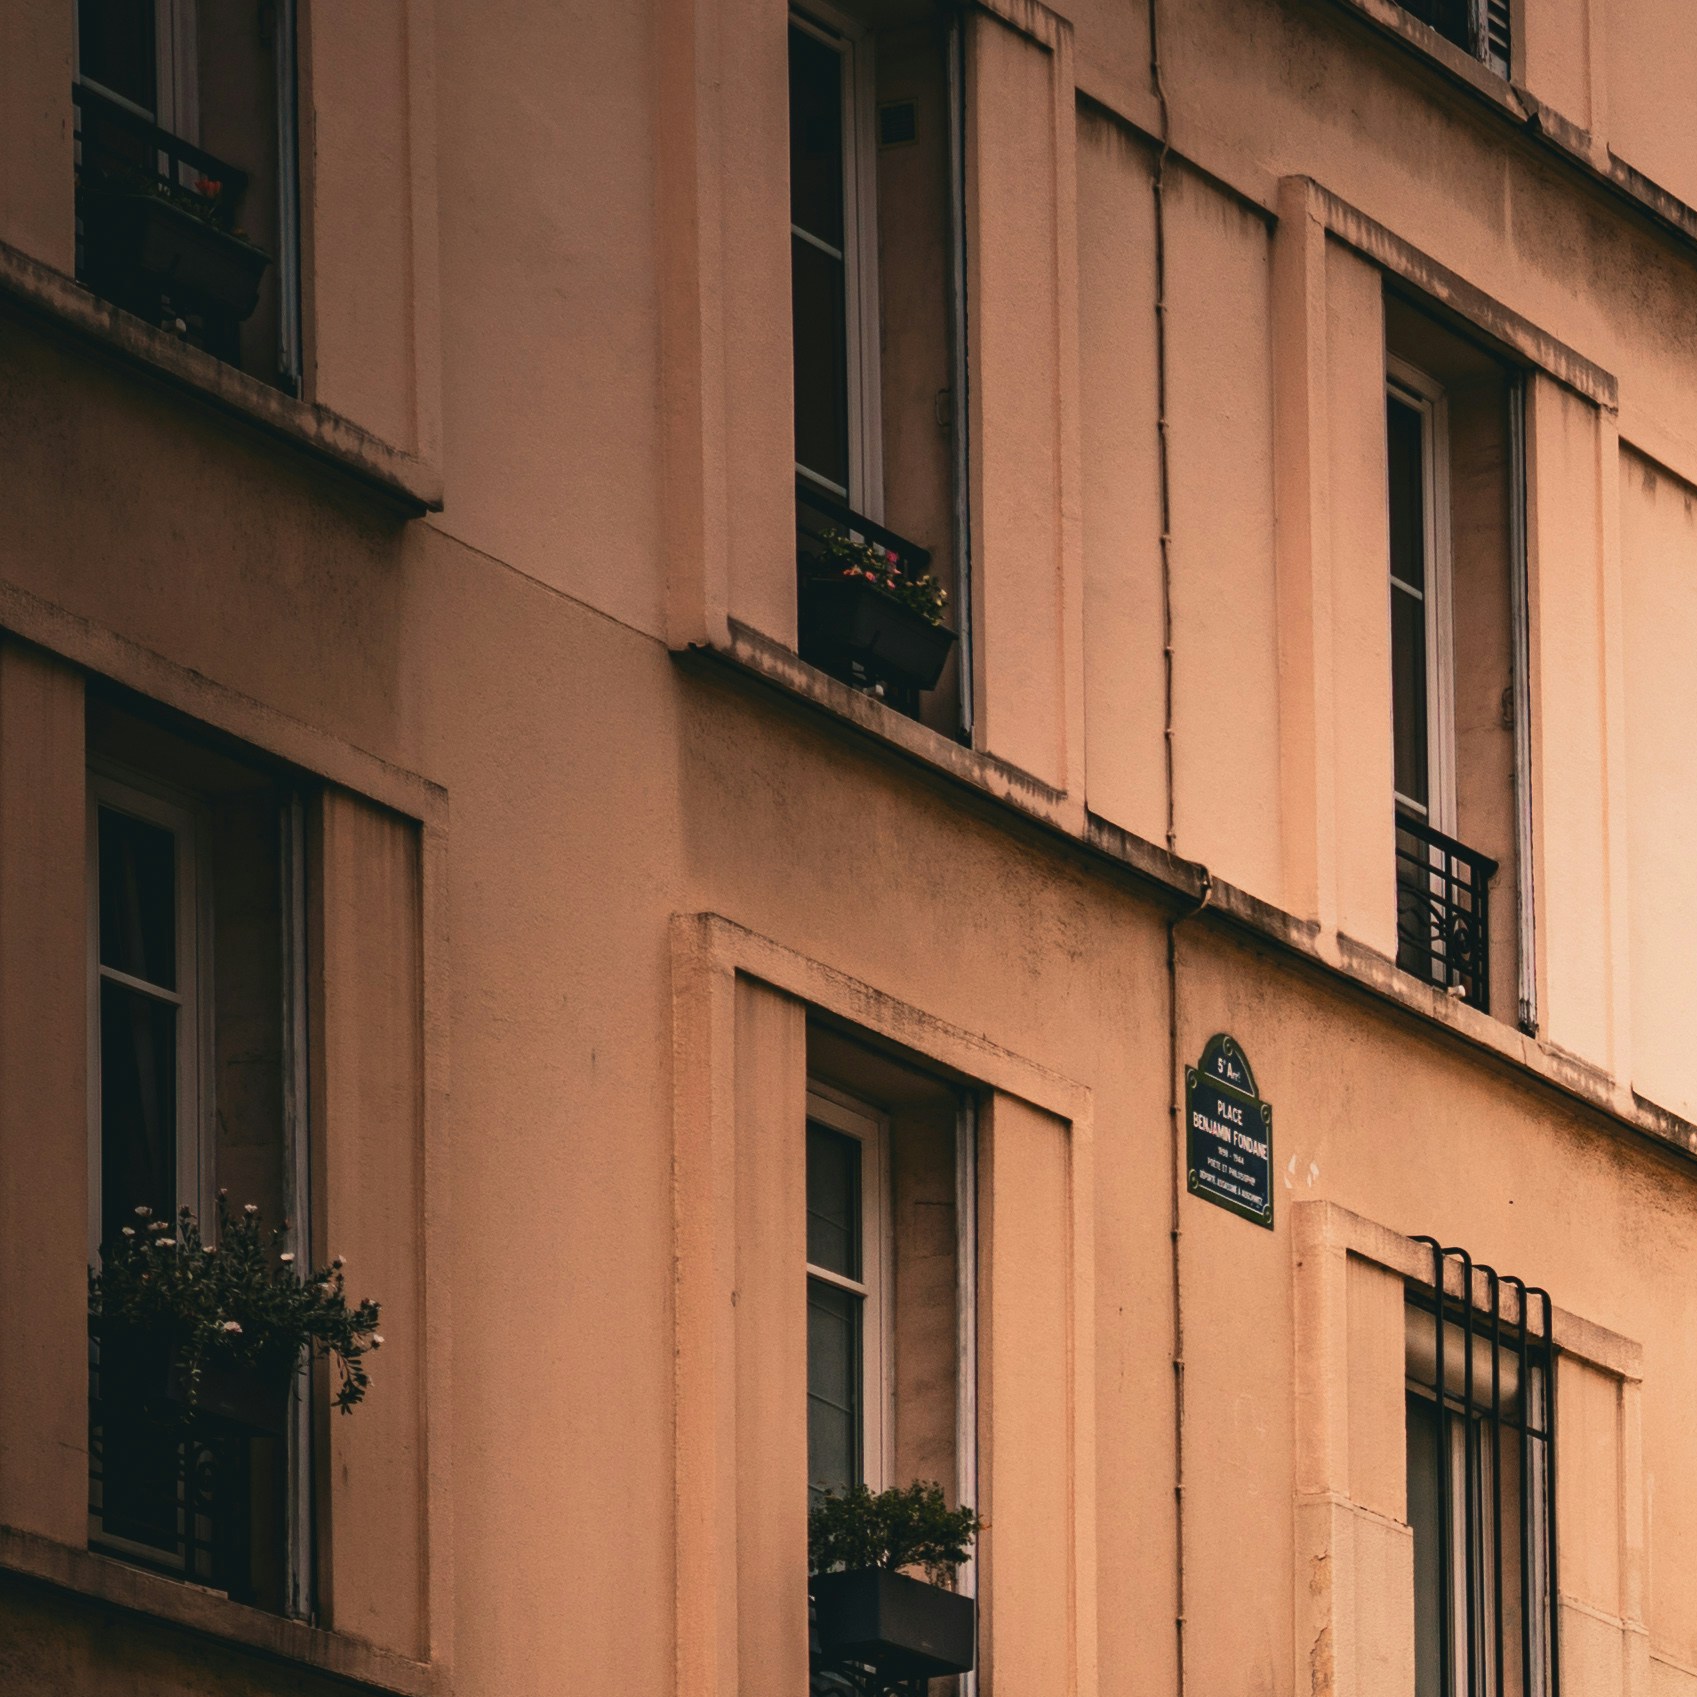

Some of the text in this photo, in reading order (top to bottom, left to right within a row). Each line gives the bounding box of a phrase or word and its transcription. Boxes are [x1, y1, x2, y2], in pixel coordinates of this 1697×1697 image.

[1218, 1100, 1243, 1126] PLACE
[1193, 1111, 1268, 1160] BENJAMIN FONDANE
[1222, 1163, 1228, 1173] ET
